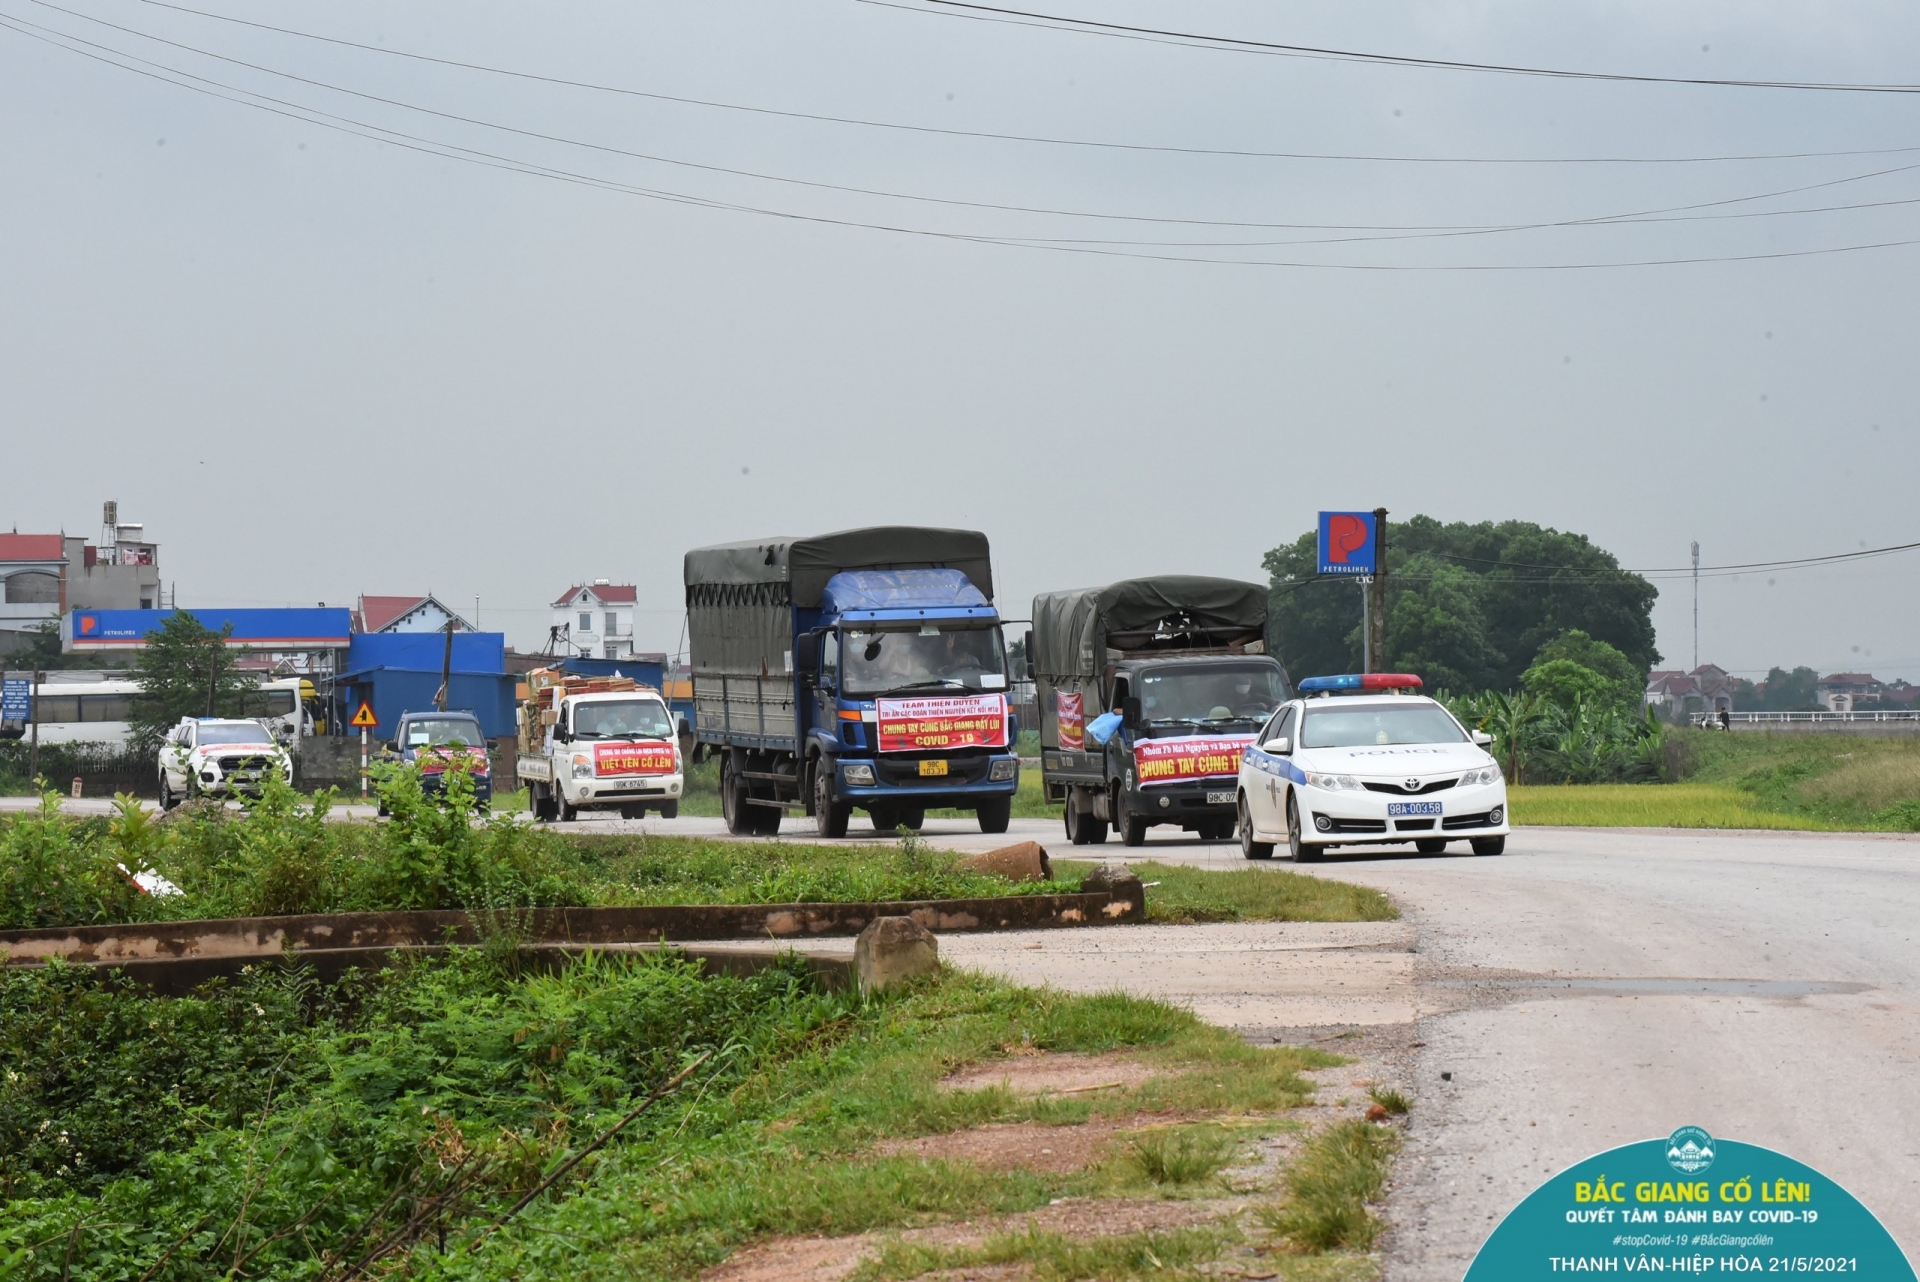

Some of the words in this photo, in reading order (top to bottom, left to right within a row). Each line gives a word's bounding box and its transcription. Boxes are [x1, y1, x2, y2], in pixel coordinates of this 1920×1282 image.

[1323, 565, 1369, 573] PETROLIMEX
[901, 701, 925, 709] TEAM
[883, 723, 907, 735] CHUNG
[907, 722, 919, 733] TAY
[920, 720, 939, 733] CÙNG
[940, 718, 953, 732] BẮC
[954, 720, 975, 731] GIANG
[990, 718, 1000, 729] LÙI
[915, 735, 949, 746] COVID
[959, 733, 975, 744] 19
[1142, 746, 1162, 757] Nhóm
[1163, 745, 1171, 754] Fb
[1172, 744, 1185, 754] Mai
[1185, 741, 1210, 754] Nguyễn
[1210, 743, 1219, 751] và
[1219, 742, 1232, 753] Bạn
[1232, 740, 1241, 749] bè
[1349, 748, 1449, 757] POLICE
[601, 757, 620, 771] VIỆT
[621, 756, 639, 769] YÊN
[641, 754, 653, 768] CỐ
[654, 755, 672, 768] LÊN
[1140, 759, 1175, 778] CHUNG
[1176, 757, 1196, 774] TAY
[1199, 752, 1229, 772] CÙNG
[1389, 802, 1441, 815] 98A-003.58
